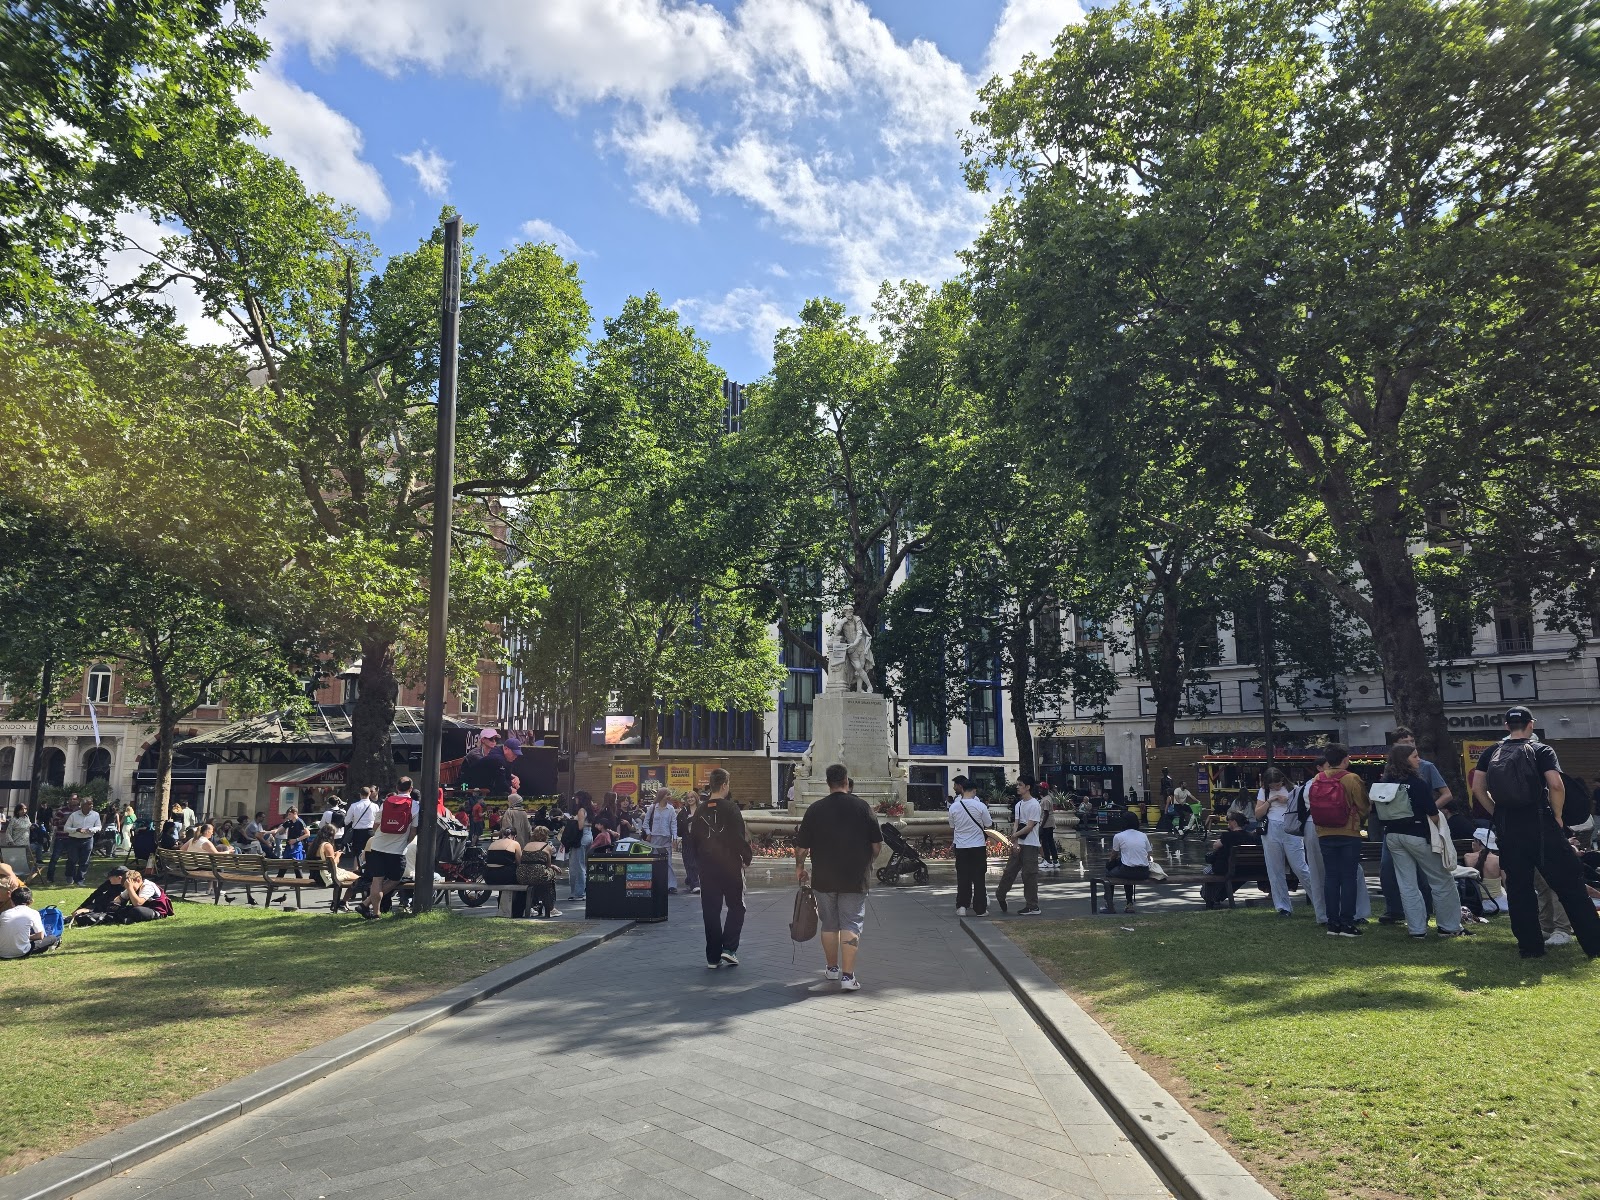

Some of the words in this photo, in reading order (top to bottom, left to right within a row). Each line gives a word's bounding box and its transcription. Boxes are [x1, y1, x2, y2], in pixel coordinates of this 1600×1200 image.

[68, 724, 95, 732] SQUAR
[1079, 724, 1105, 736] ONE
[1218, 720, 1242, 733] BAR
